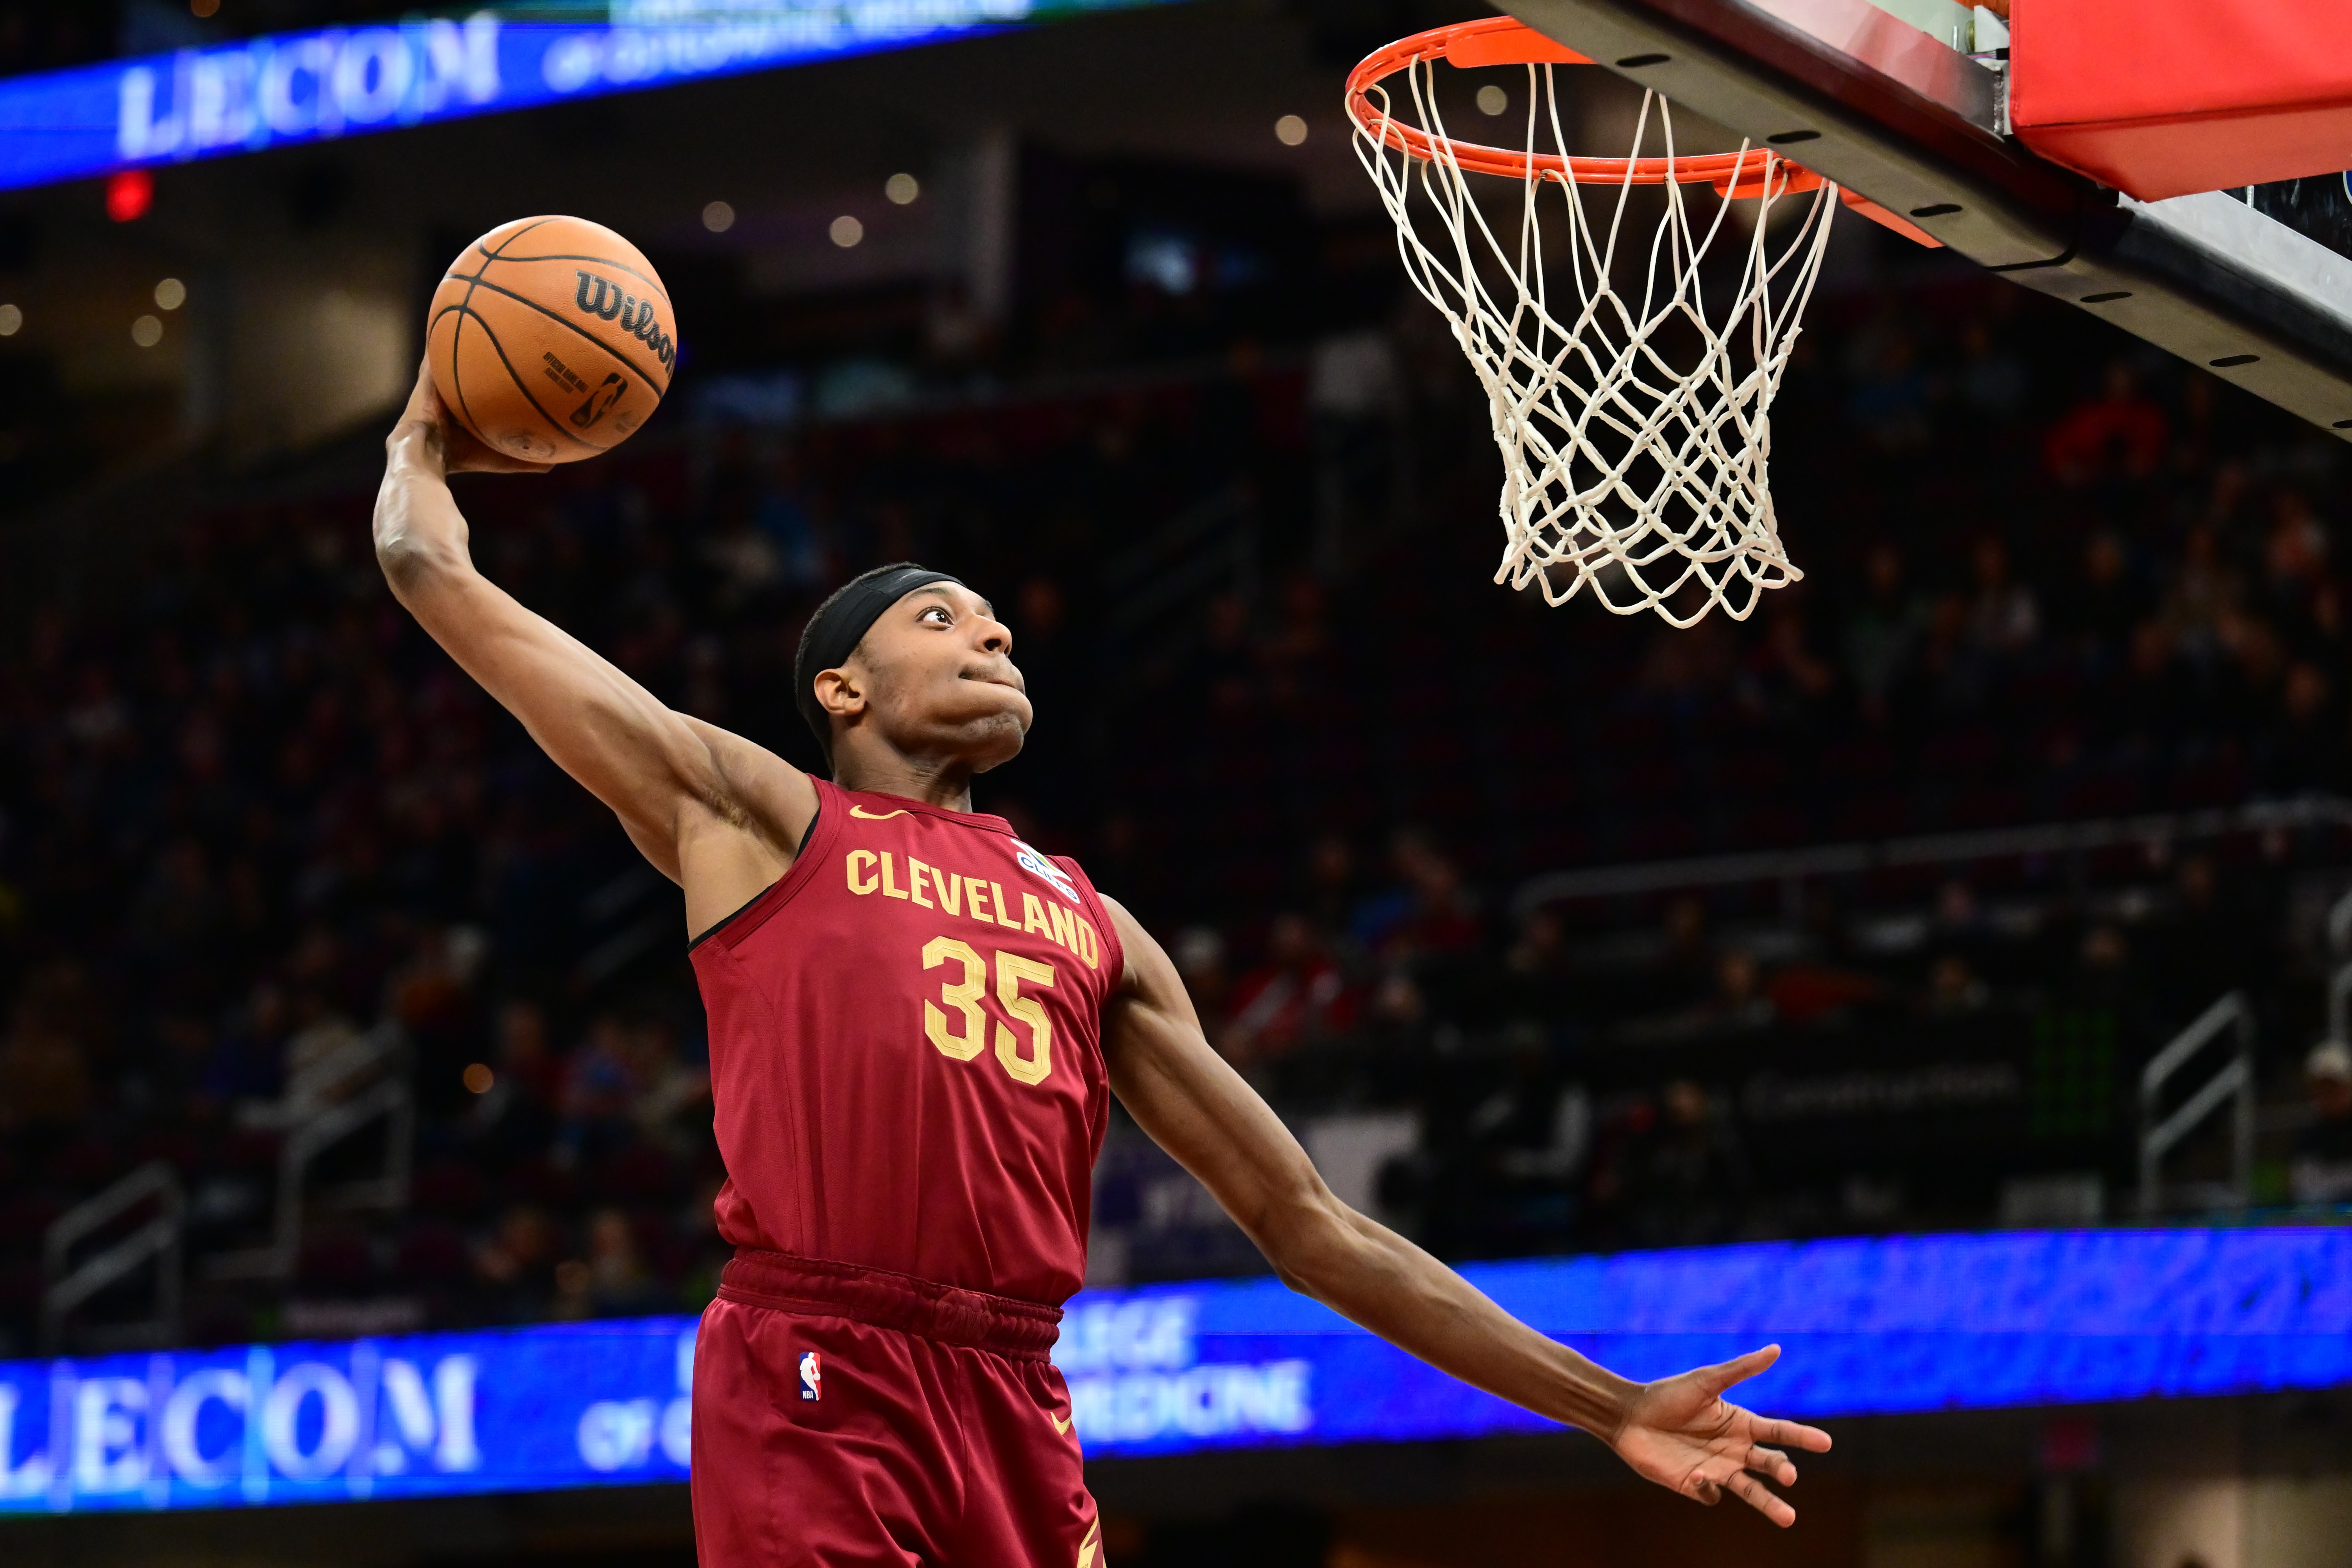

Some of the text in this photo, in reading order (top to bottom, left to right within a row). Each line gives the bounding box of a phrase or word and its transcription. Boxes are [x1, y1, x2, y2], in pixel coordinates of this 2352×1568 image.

[575, 269, 676, 381] Wilson
[846, 849, 1098, 970] CLEVELAND
[1020, 857, 1078, 900] CLIFFS
[922, 936, 1054, 1086] 35
[934, 1301, 995, 1341] CAVS
[802, 1390, 814, 1399] NBA
